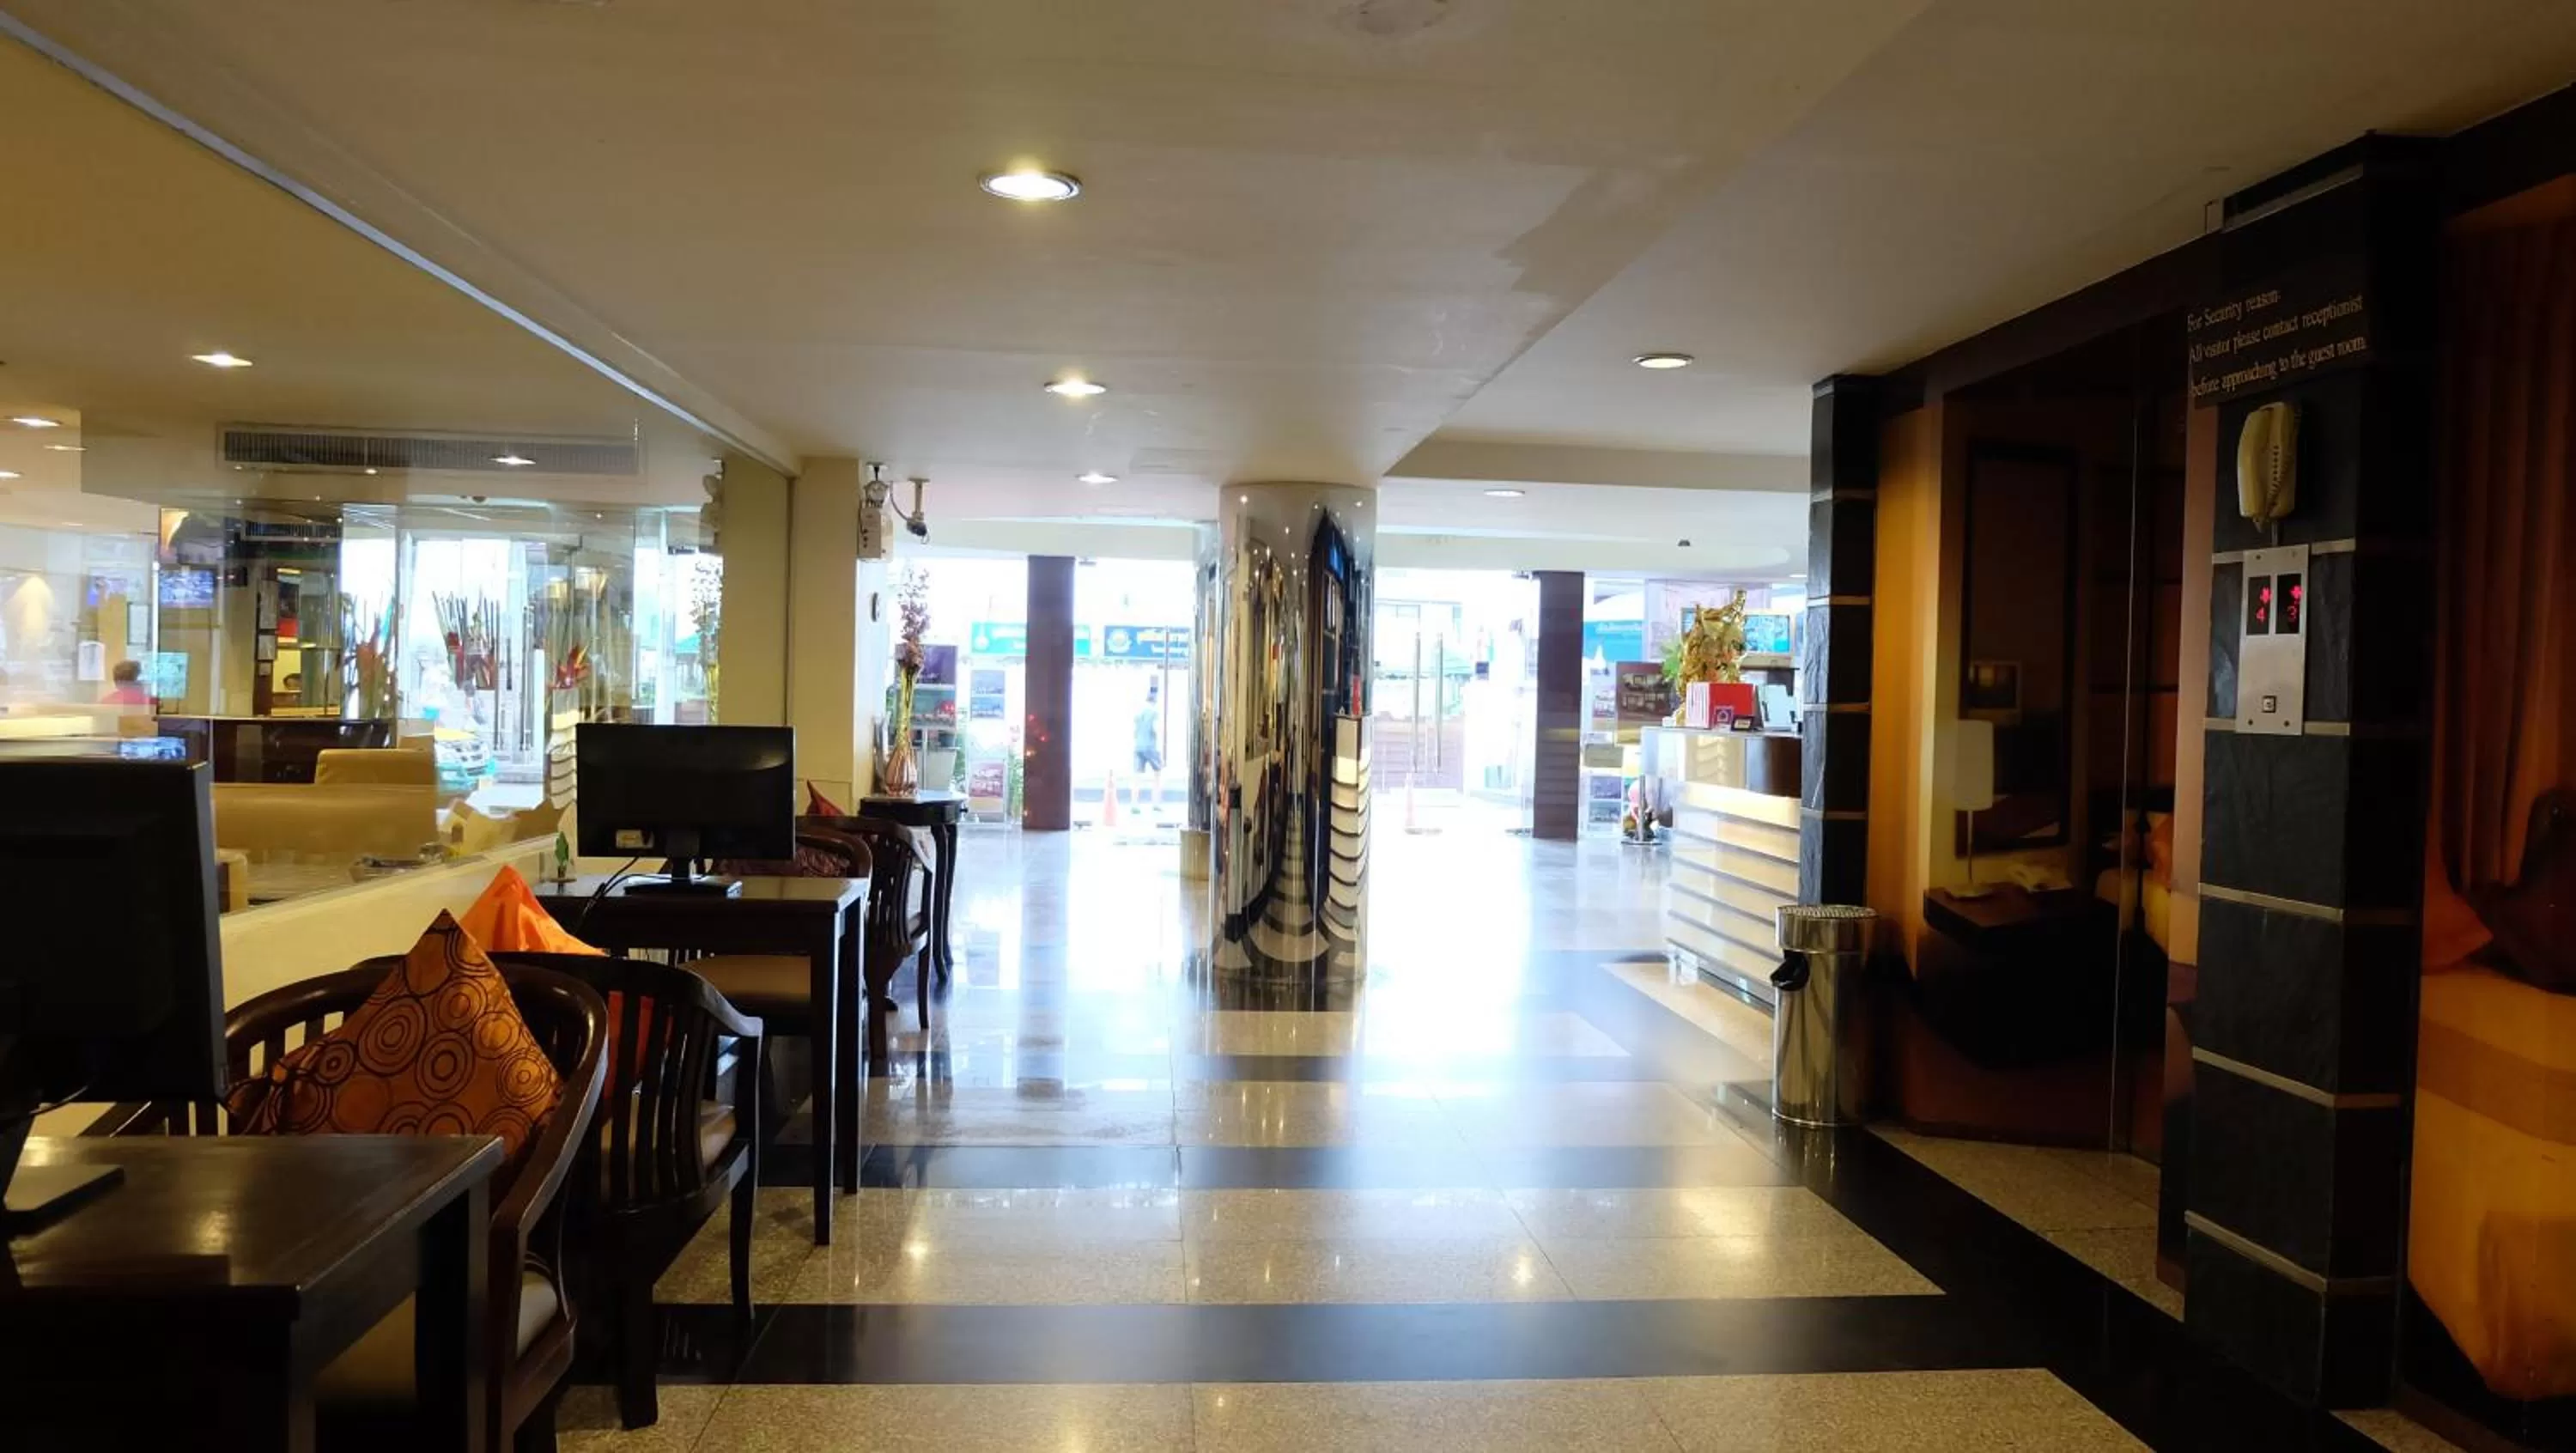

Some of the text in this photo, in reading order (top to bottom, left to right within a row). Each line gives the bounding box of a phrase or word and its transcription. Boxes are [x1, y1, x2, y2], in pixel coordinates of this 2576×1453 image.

[2187, 313, 2203, 332] For
[2204, 301, 2243, 325] Security
[2233, 330, 2261, 354] please
[2263, 315, 2299, 341] contact
[2302, 295, 2364, 328] receptionist
[2221, 361, 2278, 392] approaching
[2279, 356, 2289, 372] to
[2291, 348, 2306, 368] the
[2307, 343, 2335, 370] guest
[2256, 606, 2268, 623] 4
[2287, 605, 2298, 623] 3
